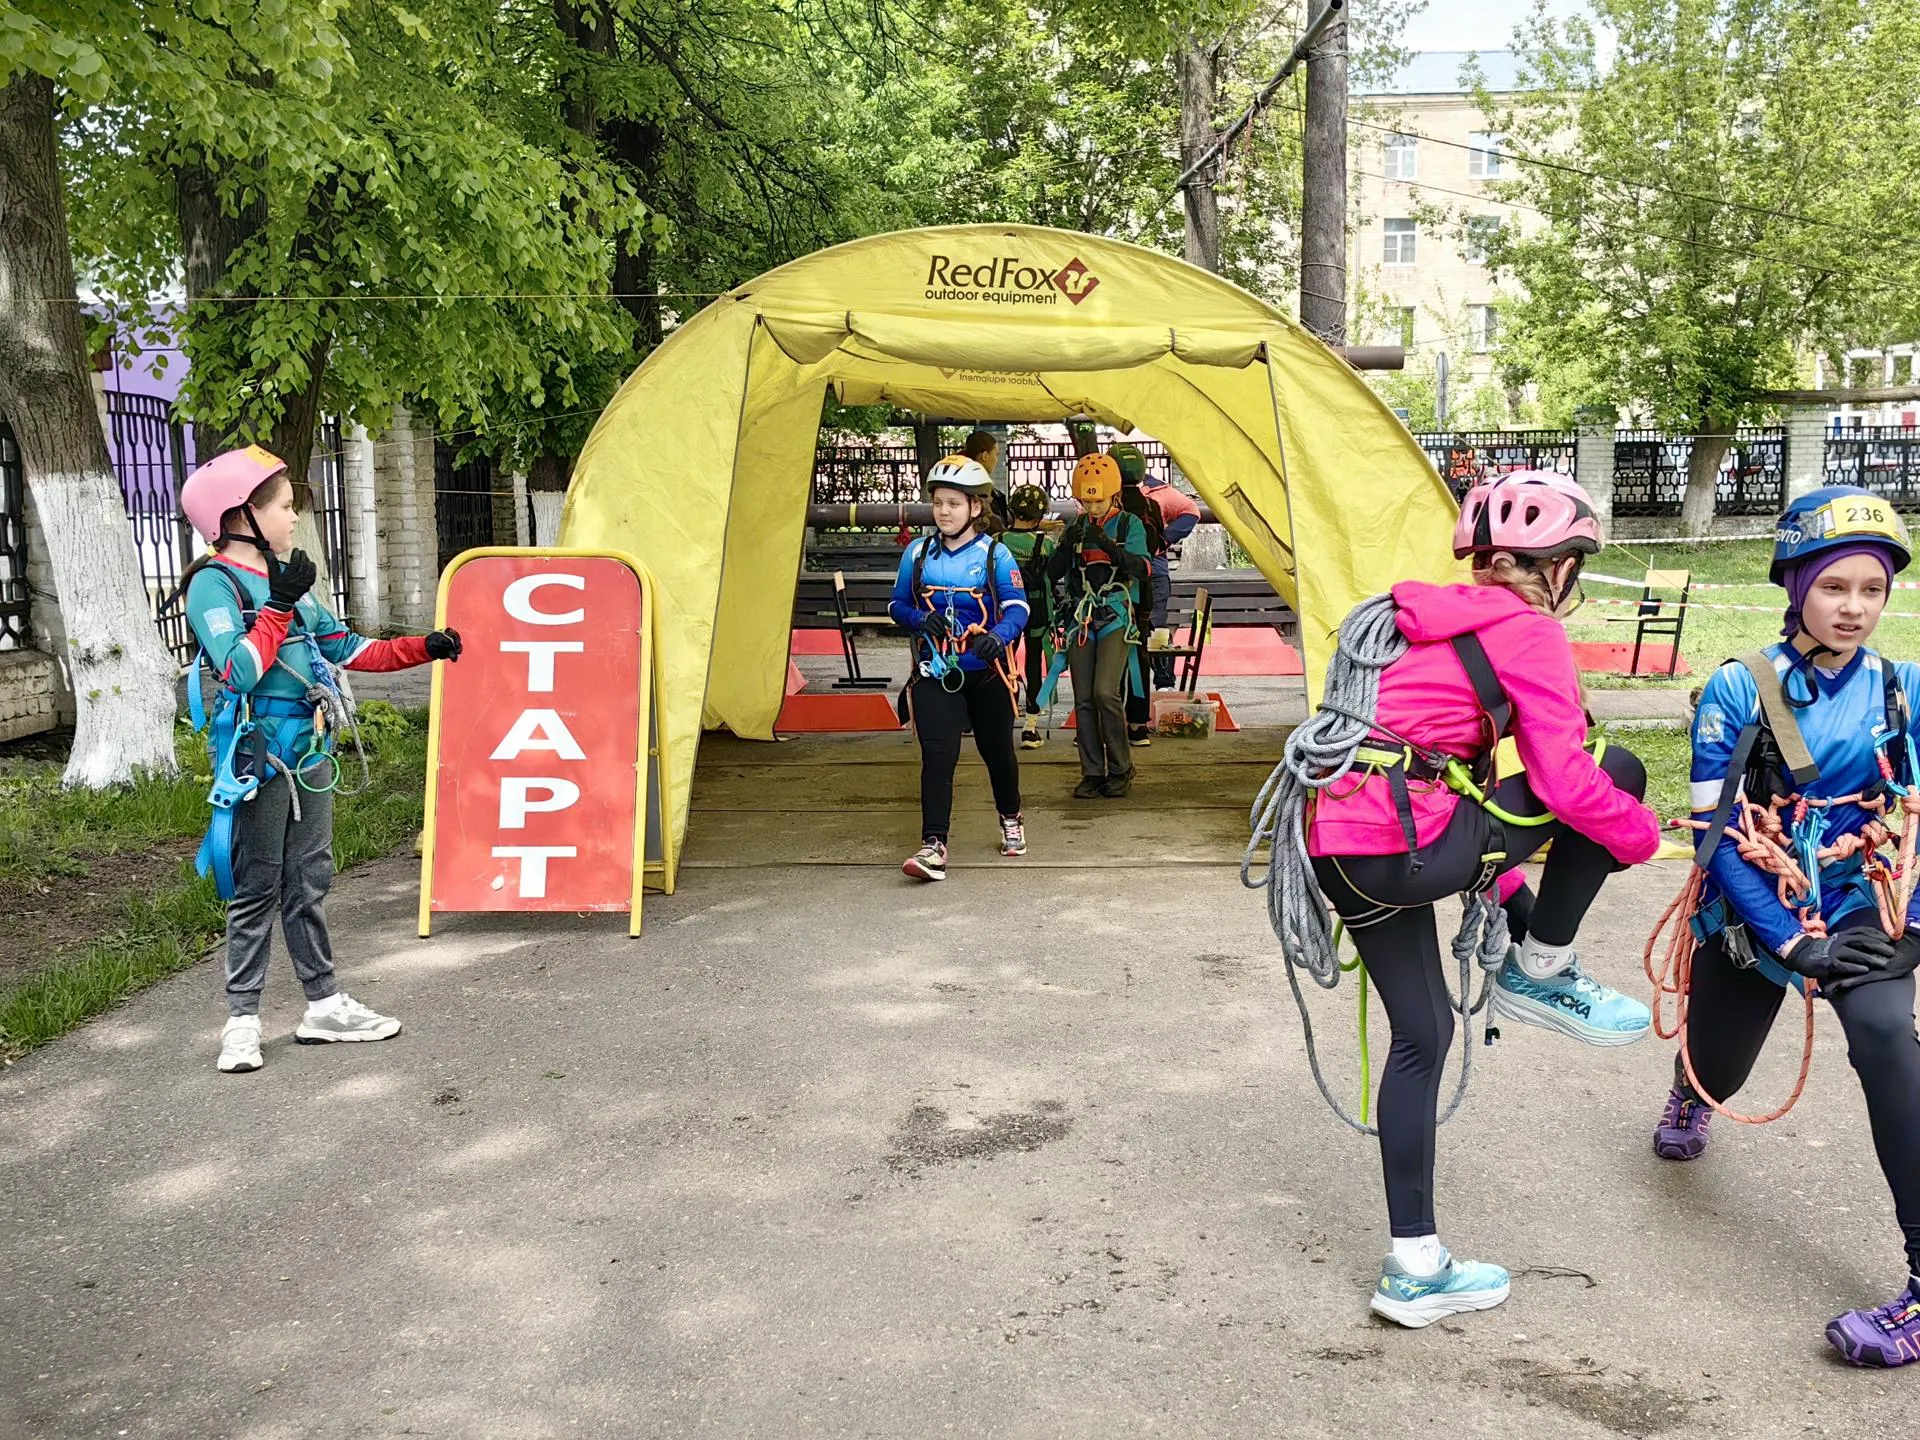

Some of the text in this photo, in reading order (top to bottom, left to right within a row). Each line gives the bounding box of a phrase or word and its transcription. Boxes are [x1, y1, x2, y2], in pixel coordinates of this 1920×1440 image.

[926, 255, 1059, 291] RedFox
[925, 287, 1057, 305] outdoor equipment
[1086, 487, 1097, 495] 49
[1846, 507, 1885, 523] 236
[1776, 528, 1802, 544] ENTO
[488, 573, 588, 898] СТАРТ
